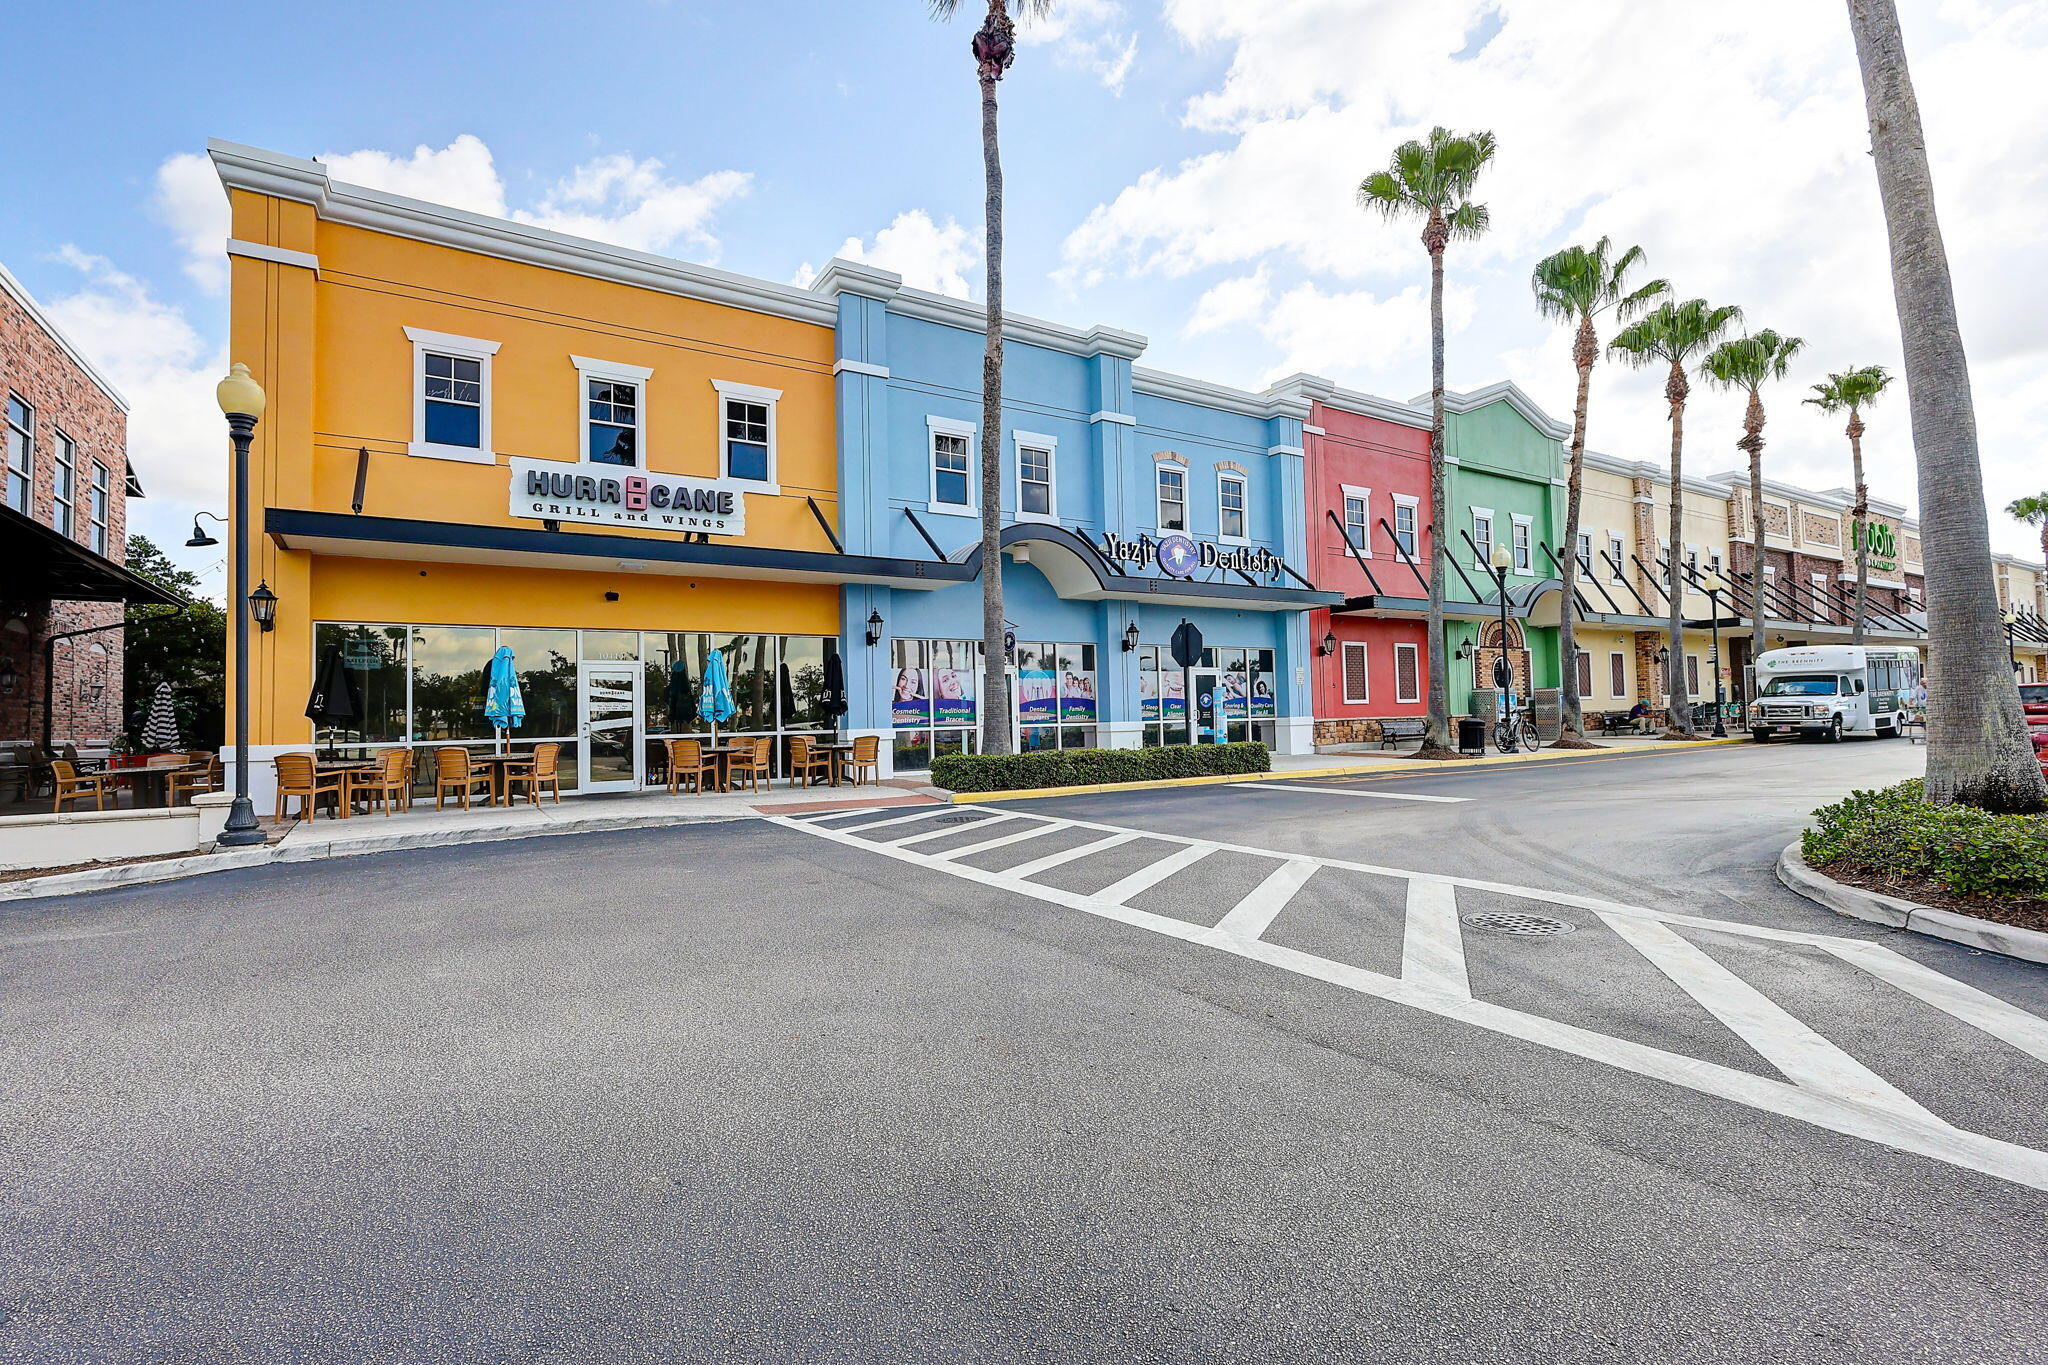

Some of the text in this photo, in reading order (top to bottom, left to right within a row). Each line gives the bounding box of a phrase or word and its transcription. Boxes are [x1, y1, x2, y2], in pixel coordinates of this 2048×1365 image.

[527, 470, 734, 514] HURRICANE
[532, 503, 725, 529] GRILL and WINGS
[1103, 532, 1284, 581] Yazji Dentistry
[1172, 536, 1197, 554] DENTISTRY
